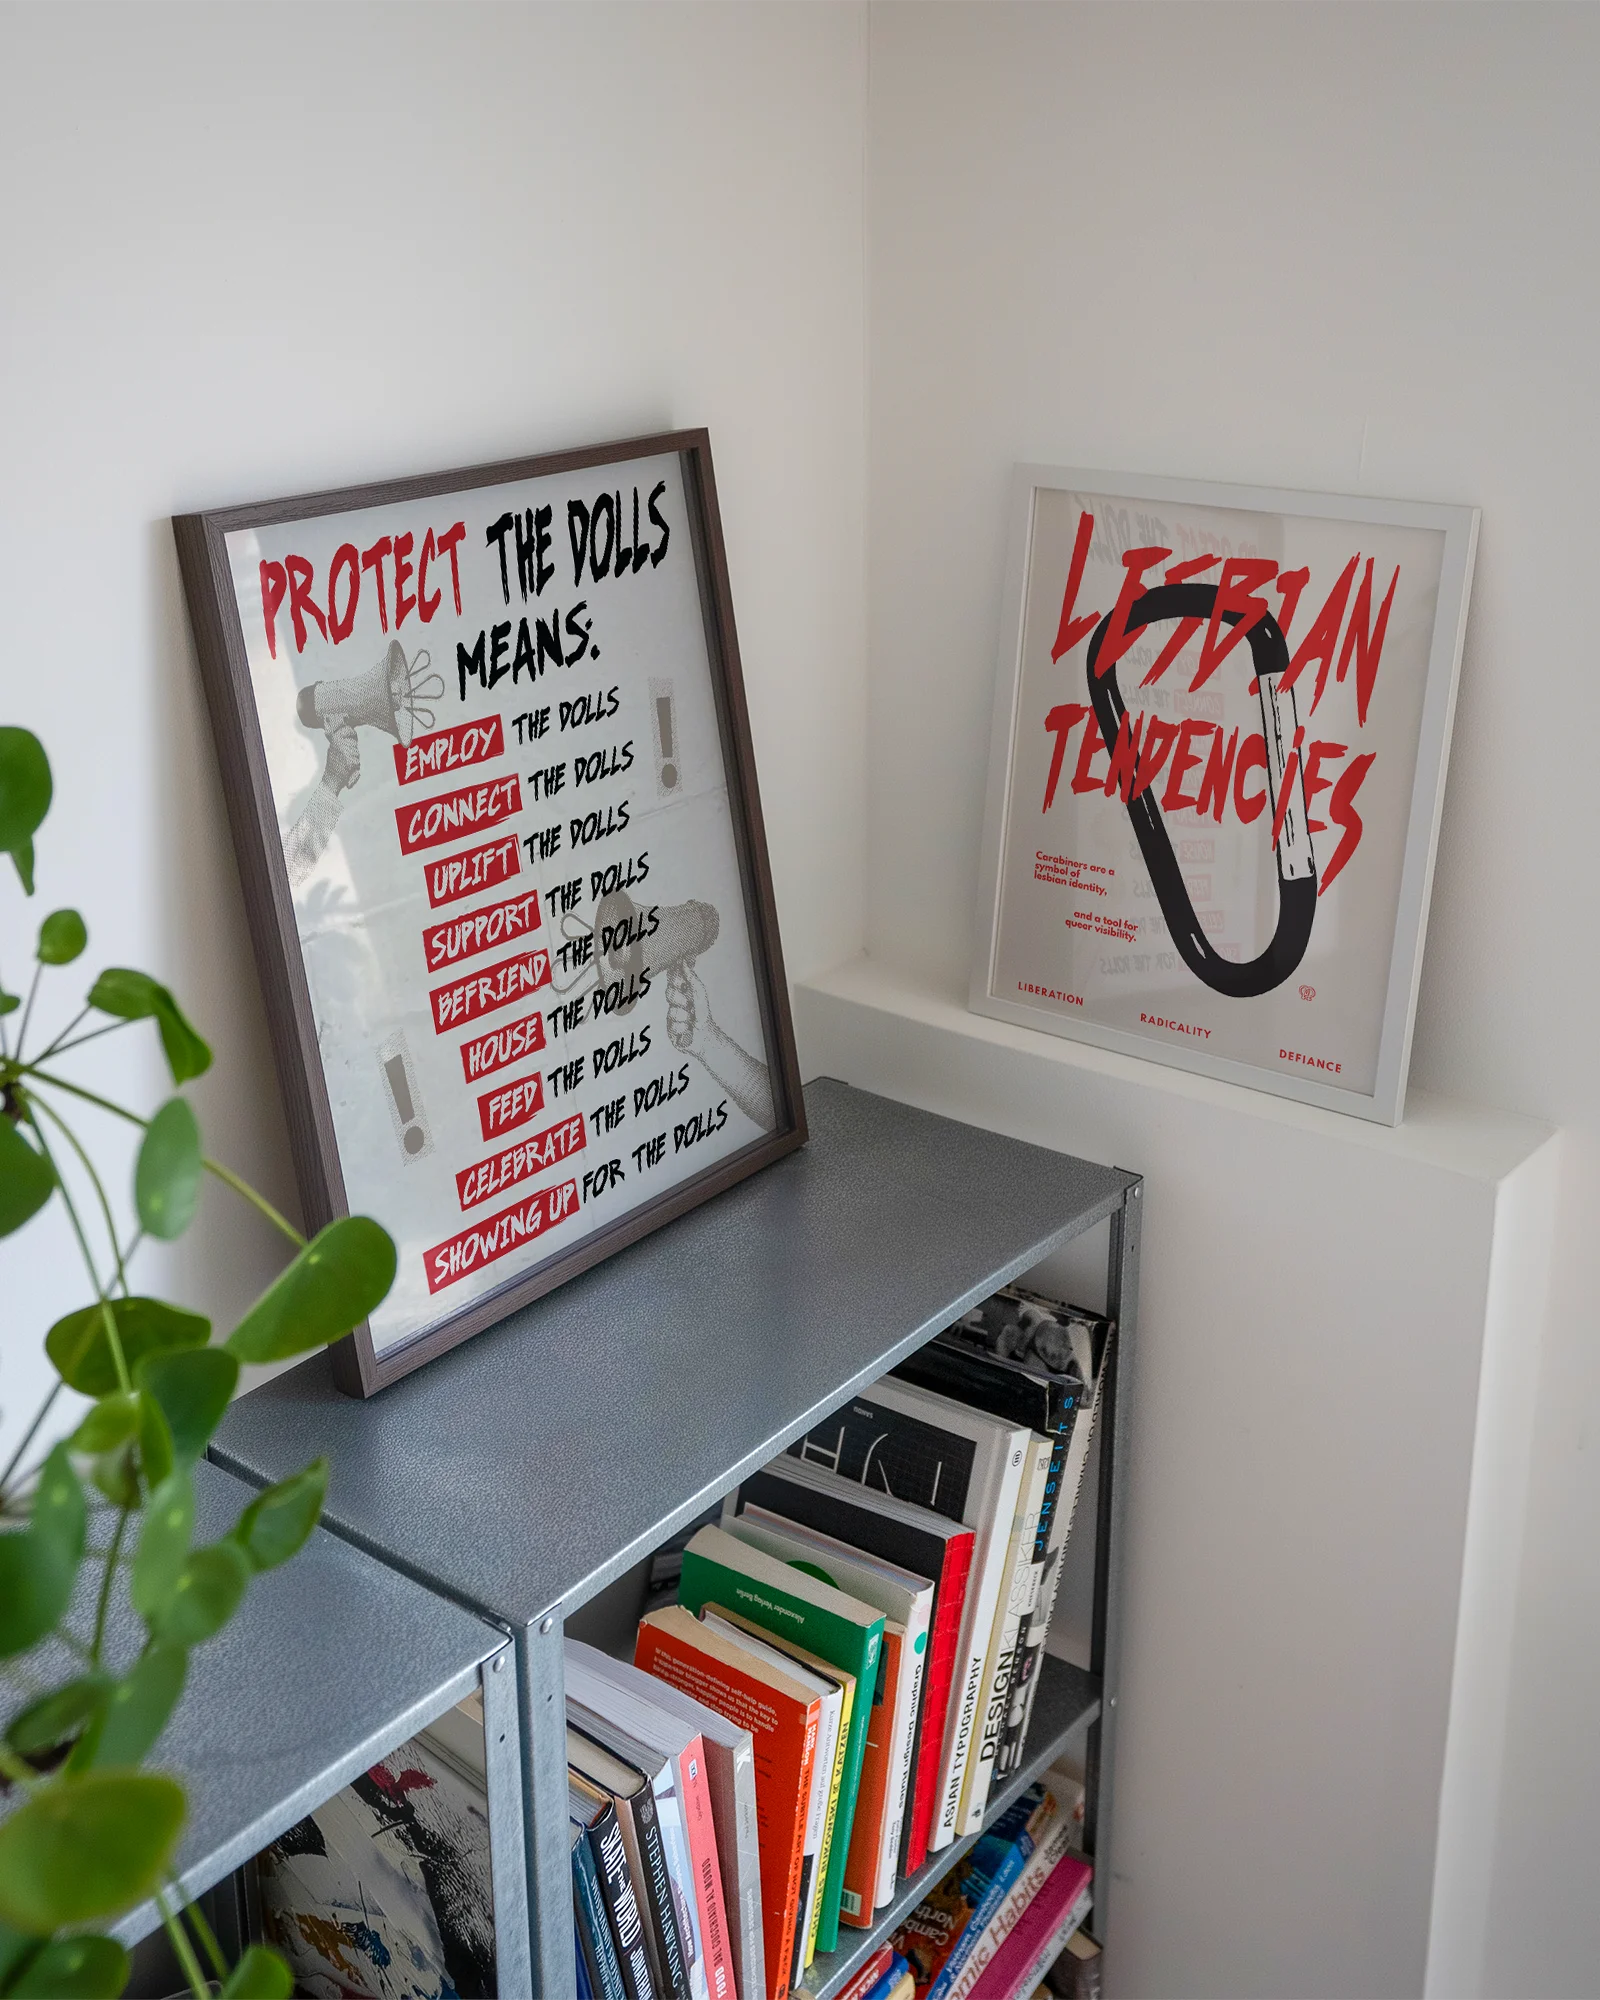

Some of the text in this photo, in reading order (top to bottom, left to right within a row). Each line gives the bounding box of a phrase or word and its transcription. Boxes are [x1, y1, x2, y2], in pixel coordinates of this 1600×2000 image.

[260, 481, 670, 659] PROTECT THE DOLLS
[456, 601, 600, 701] MEANS:
[1051, 511, 1400, 727] LESBIAN
[404, 686, 619, 780] EMPLOY THE DOLLS
[407, 741, 634, 844] CONNECT THE DOLLS
[1042, 703, 1376, 896] TENDENCIES
[432, 800, 630, 899] UPLIFT THE DOLLS
[1034, 870, 1107, 896] lesbian identity,
[1035, 862, 1080, 878] symbol of
[1036, 850, 1088, 870] Carabiners
[1090, 864, 1106, 874] are
[430, 852, 649, 965] SUPPORT THE DOLLS
[1065, 919, 1137, 943] queer visibility.
[1074, 911, 1092, 921] and
[1103, 917, 1122, 928] tool
[1124, 920, 1138, 931] for
[438, 906, 660, 1023] BEFRIEND THE DOLLS
[1018, 981, 1084, 1006] LIBERATION
[468, 967, 651, 1076] HOUSE THE DOLLS
[1140, 1012, 1212, 1039] RADICALITY
[1278, 1048, 1342, 1074] DEFIANCE
[487, 1026, 651, 1132] FEED THE DOLLS
[462, 1064, 690, 1202] CELEBRATE THE DOLLS
[434, 1101, 728, 1283] SHOWING UP FOR THE DOLLS
[1034, 1396, 1074, 1551] JENSEITS
[736, 1588, 805, 1624] Alexander Verlag Berlin
[685, 1672, 709, 1688] blogger
[709, 1684, 727, 1698] shows
[736, 1698, 748, 1709] that
[749, 1705, 759, 1715] the
[759, 1710, 771, 1722] key
[771, 1716, 779, 1726] to
[718, 1697, 739, 1714] people
[740, 1708, 745, 1716] is
[746, 1711, 753, 1721] to
[754, 1716, 775, 1732] handle
[723, 1709, 742, 1725] trying
[742, 1720, 750, 1729] to
[750, 1725, 759, 1733] be
[731, 1687, 757, 1705] self-help
[827, 1710, 835, 1732] Kurze
[898, 1663, 922, 1809] Graphic Design Rules
[821, 1733, 831, 1776] Antworten
[943, 1656, 982, 1828] ASIAN TYPOGRAPHY
[799, 1791, 808, 1832] SUBTLE
[811, 1721, 849, 1938] CHARLES BUKOWSKI KATZEN
[600, 1821, 642, 1949] SKATE THE WORLD
[646, 1826, 668, 1907] STEPHEN
[660, 1904, 683, 1989] HAWKING
[702, 1857, 713, 1890] MONDO
[989, 1867, 1045, 1947] Habits
[713, 1948, 723, 1967] DAL
[714, 1965, 727, 1999] FOOD
